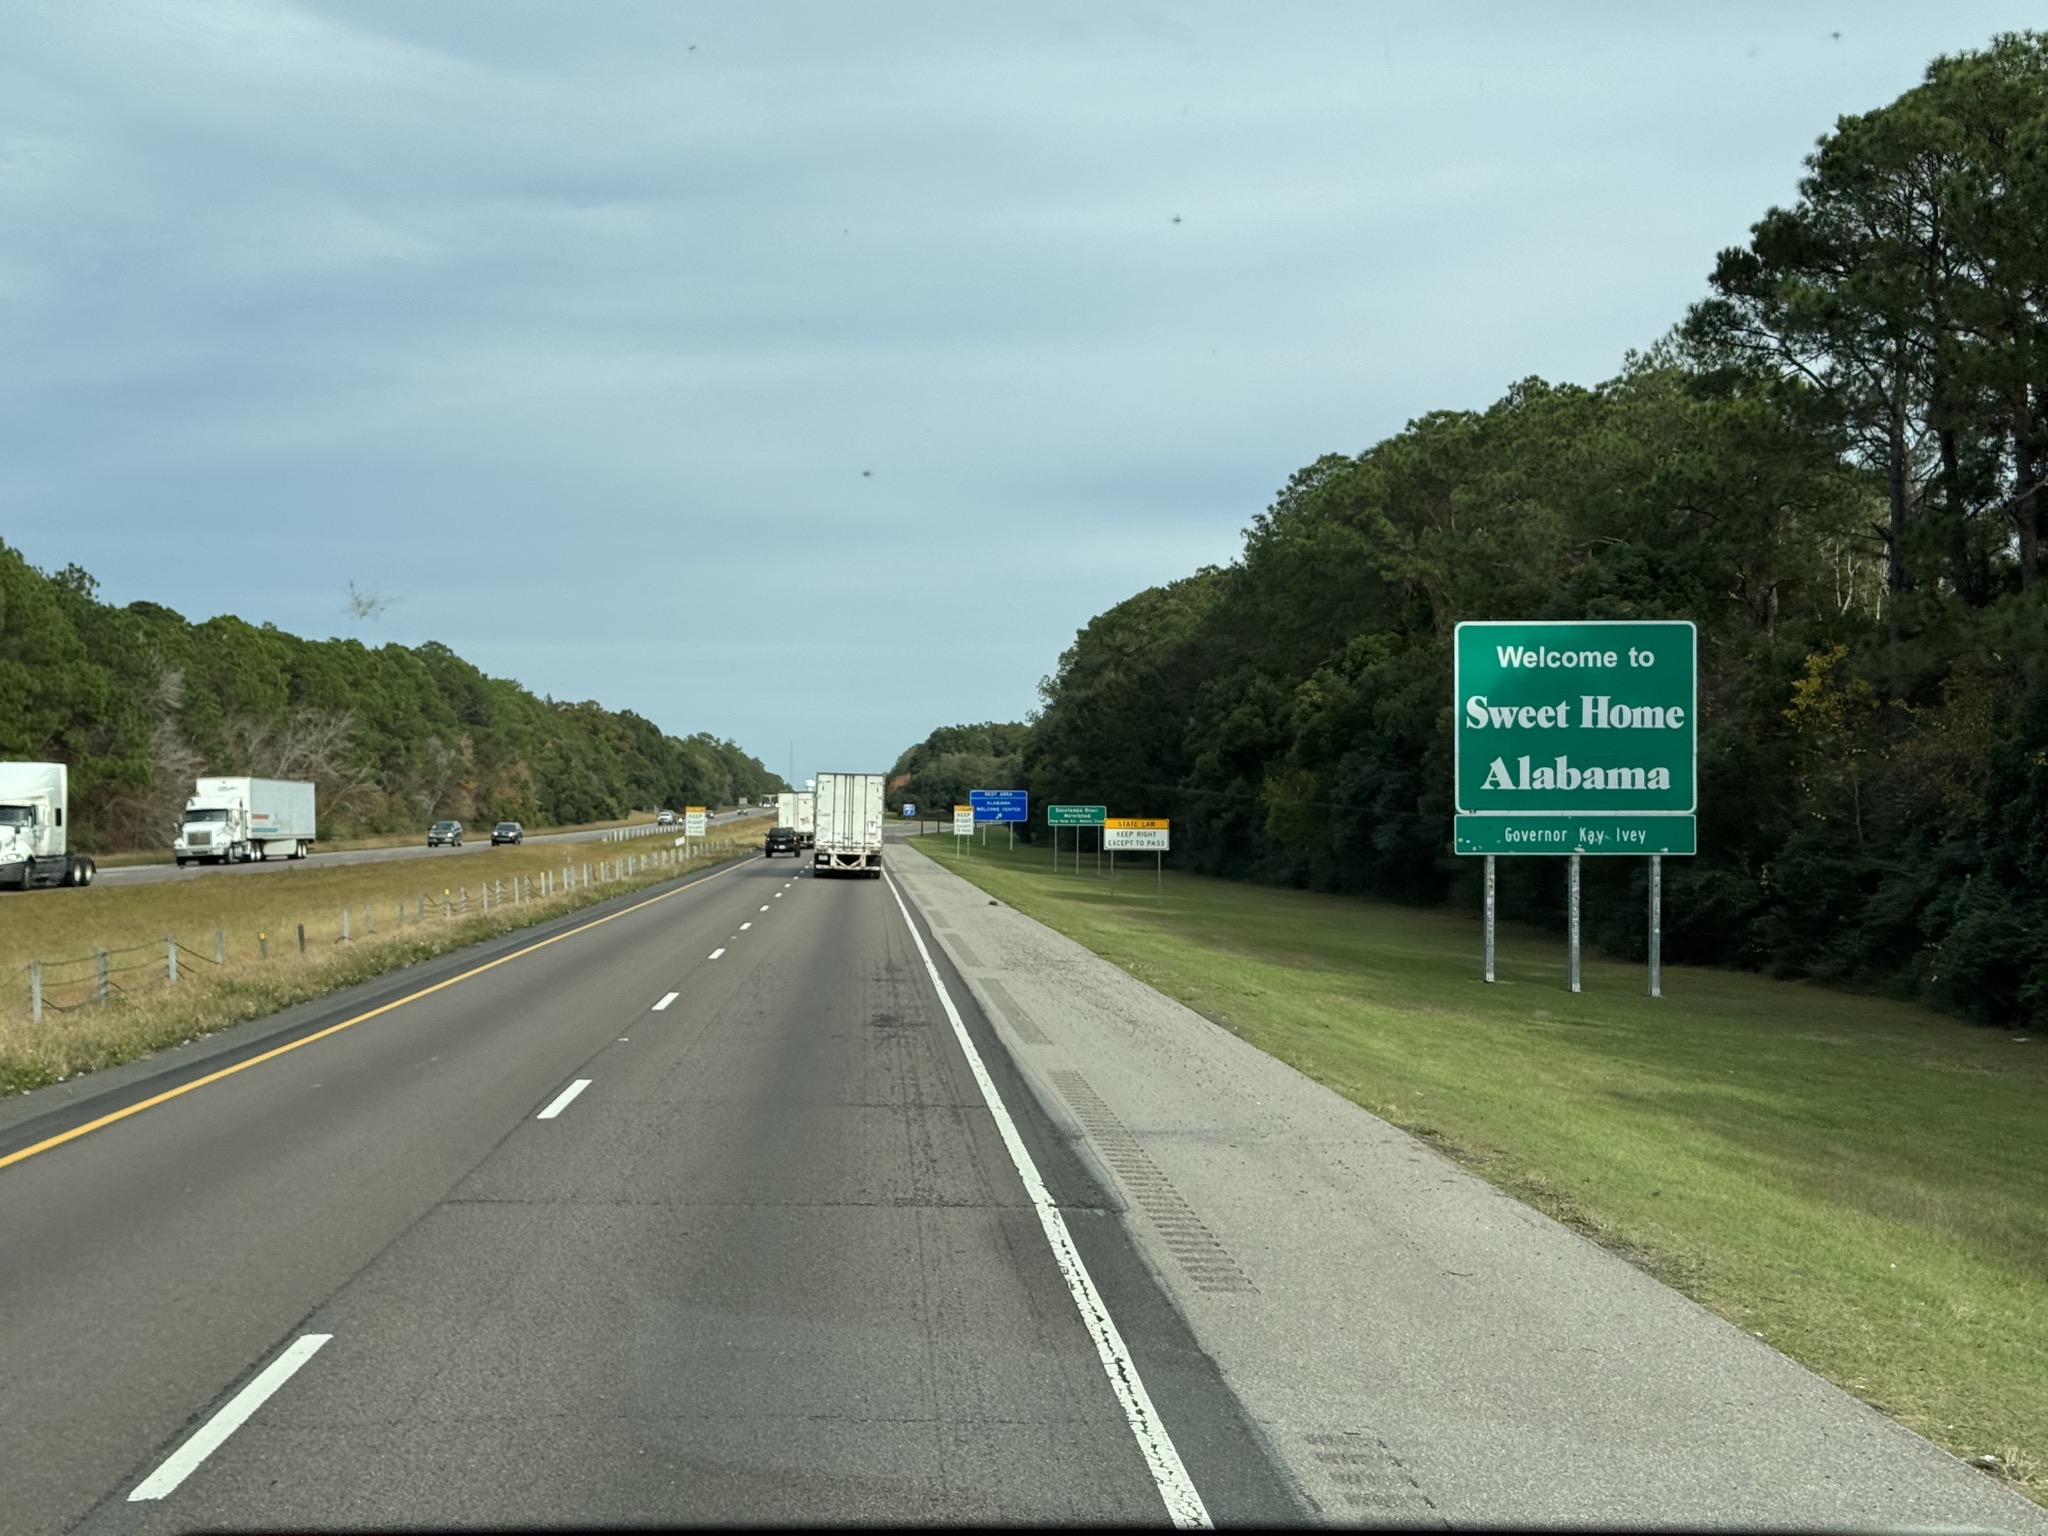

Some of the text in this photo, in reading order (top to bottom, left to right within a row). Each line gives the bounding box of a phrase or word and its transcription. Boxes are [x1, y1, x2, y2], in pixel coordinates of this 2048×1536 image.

[1496, 645, 1655, 668] Welcome to
[1466, 695, 1685, 729] Sweet Home
[1480, 755, 1671, 790] Alabama
[1504, 827, 1647, 845] Governor Kay Ivey
